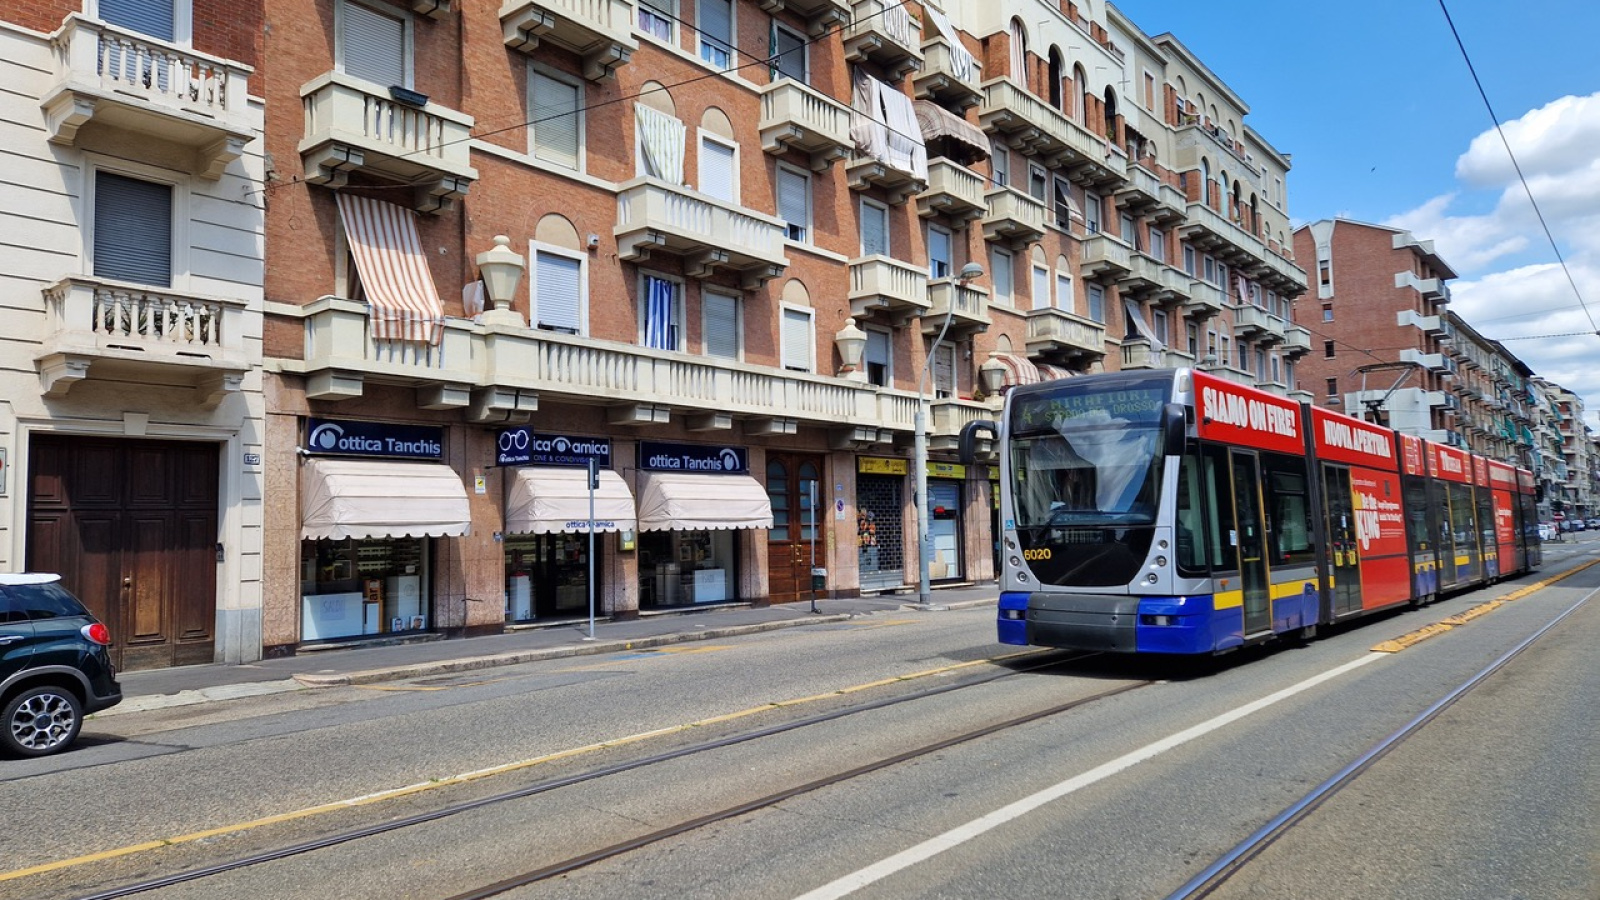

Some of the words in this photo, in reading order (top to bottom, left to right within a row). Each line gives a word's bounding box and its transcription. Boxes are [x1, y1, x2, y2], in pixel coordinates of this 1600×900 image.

[1051, 390, 1150, 410] MIRAFIORI
[1203, 386, 1248, 428] SIAMO
[1249, 399, 1267, 431] ON
[1266, 403, 1297, 438] FIRE!
[339, 436, 381, 451] ottica
[385, 437, 441, 454] Tanchis
[533, 436, 551, 451] ica
[572, 440, 609, 455] amica
[1323, 418, 1354, 450] NUOVA
[1353, 427, 1391, 458] APERTURA
[649, 454, 681, 468] ottica
[682, 455, 722, 470] Tanchis
[1024, 548, 1052, 560] 6020
